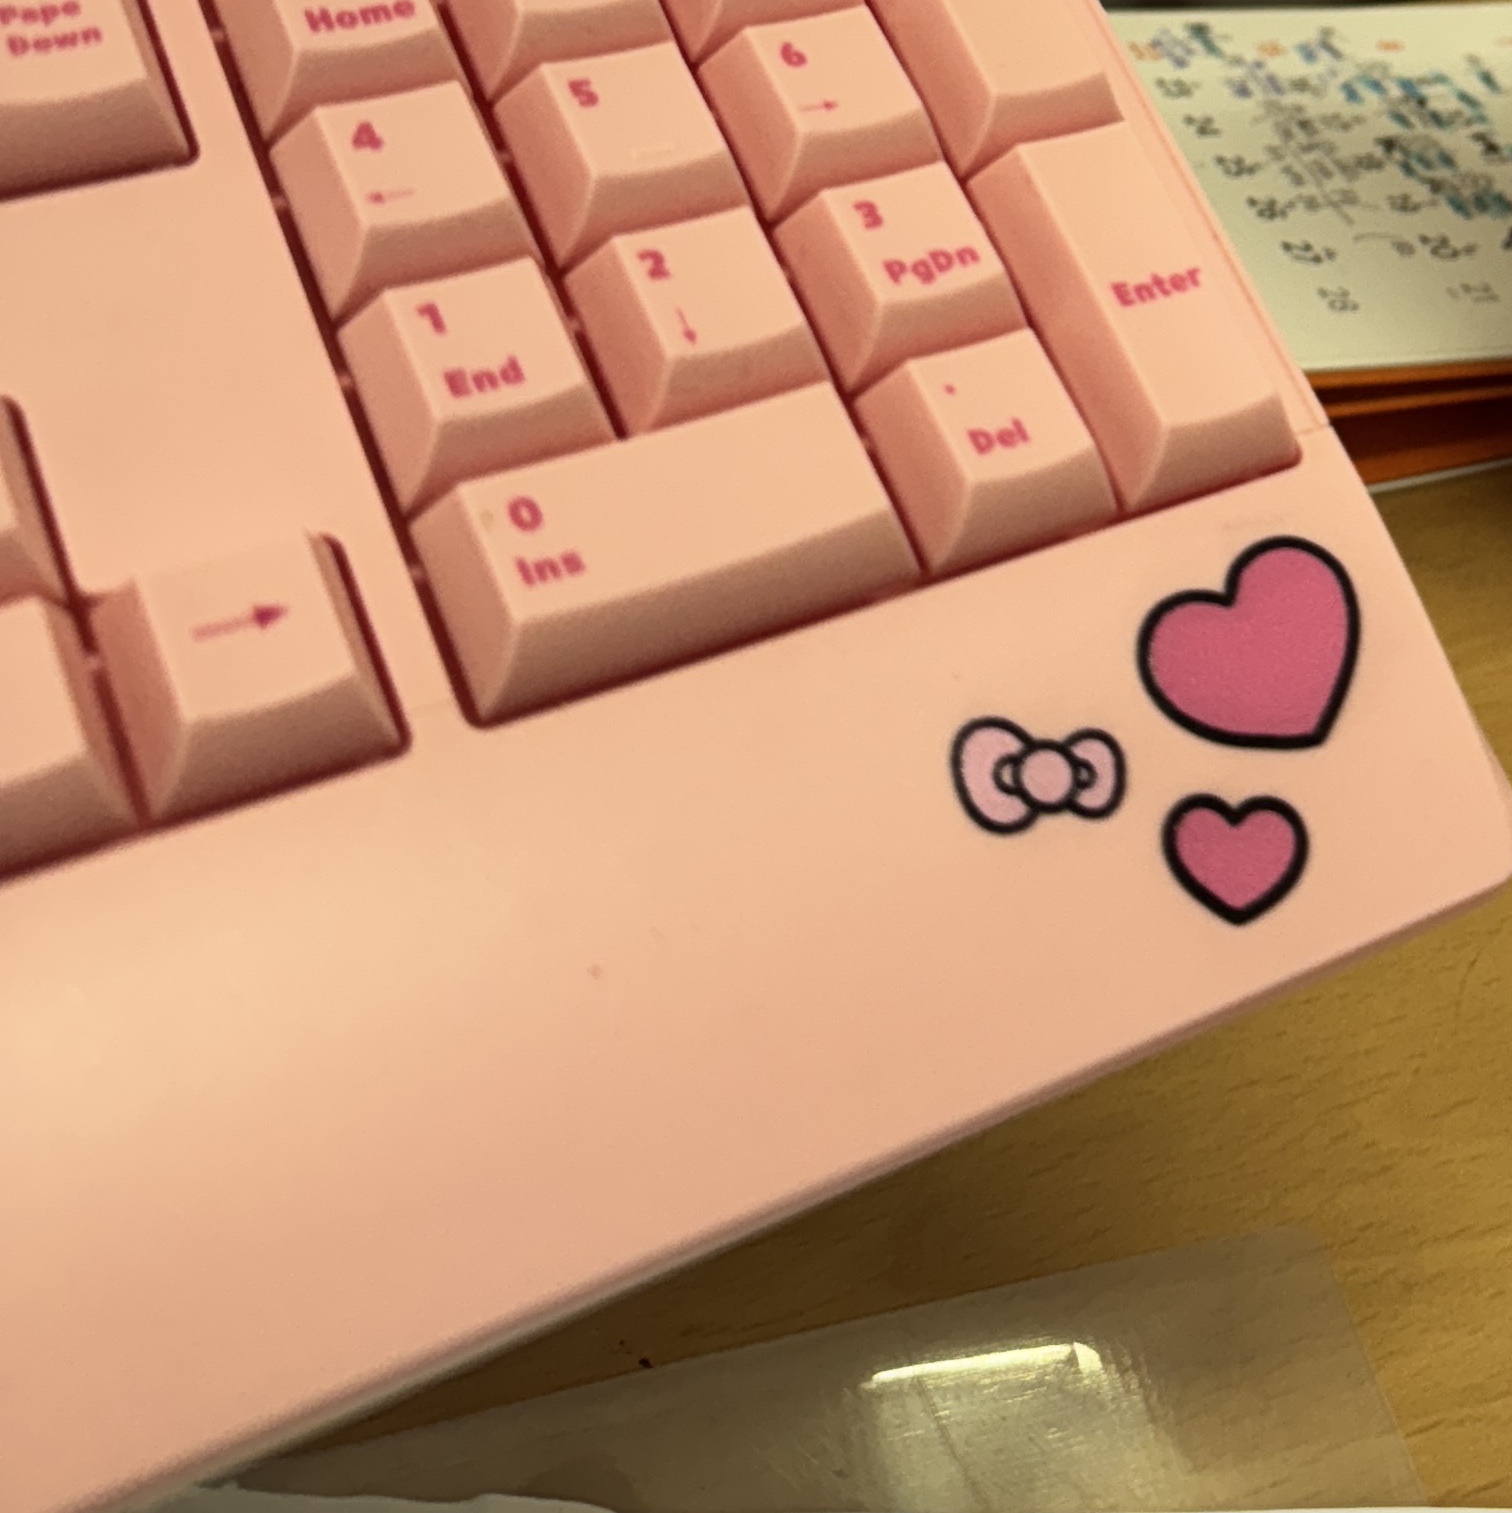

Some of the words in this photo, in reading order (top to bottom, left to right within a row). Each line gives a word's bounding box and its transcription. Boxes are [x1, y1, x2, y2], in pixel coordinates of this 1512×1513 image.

[304, 0, 415, 33] Home
[7, 26, 102, 56] Down
[780, 42, 807, 68] 6
[568, 79, 599, 108] 5
[351, 122, 384, 151] 4
[854, 201, 883, 229] 3
[638, 250, 669, 280] 2
[883, 245, 980, 285] PgDn
[1110, 268, 1200, 307] Enter
[417, 303, 446, 334] 1
[443, 357, 525, 398] End
[967, 418, 1030, 455] Del
[508, 497, 543, 532] 0
[516, 553, 584, 586] Ins
